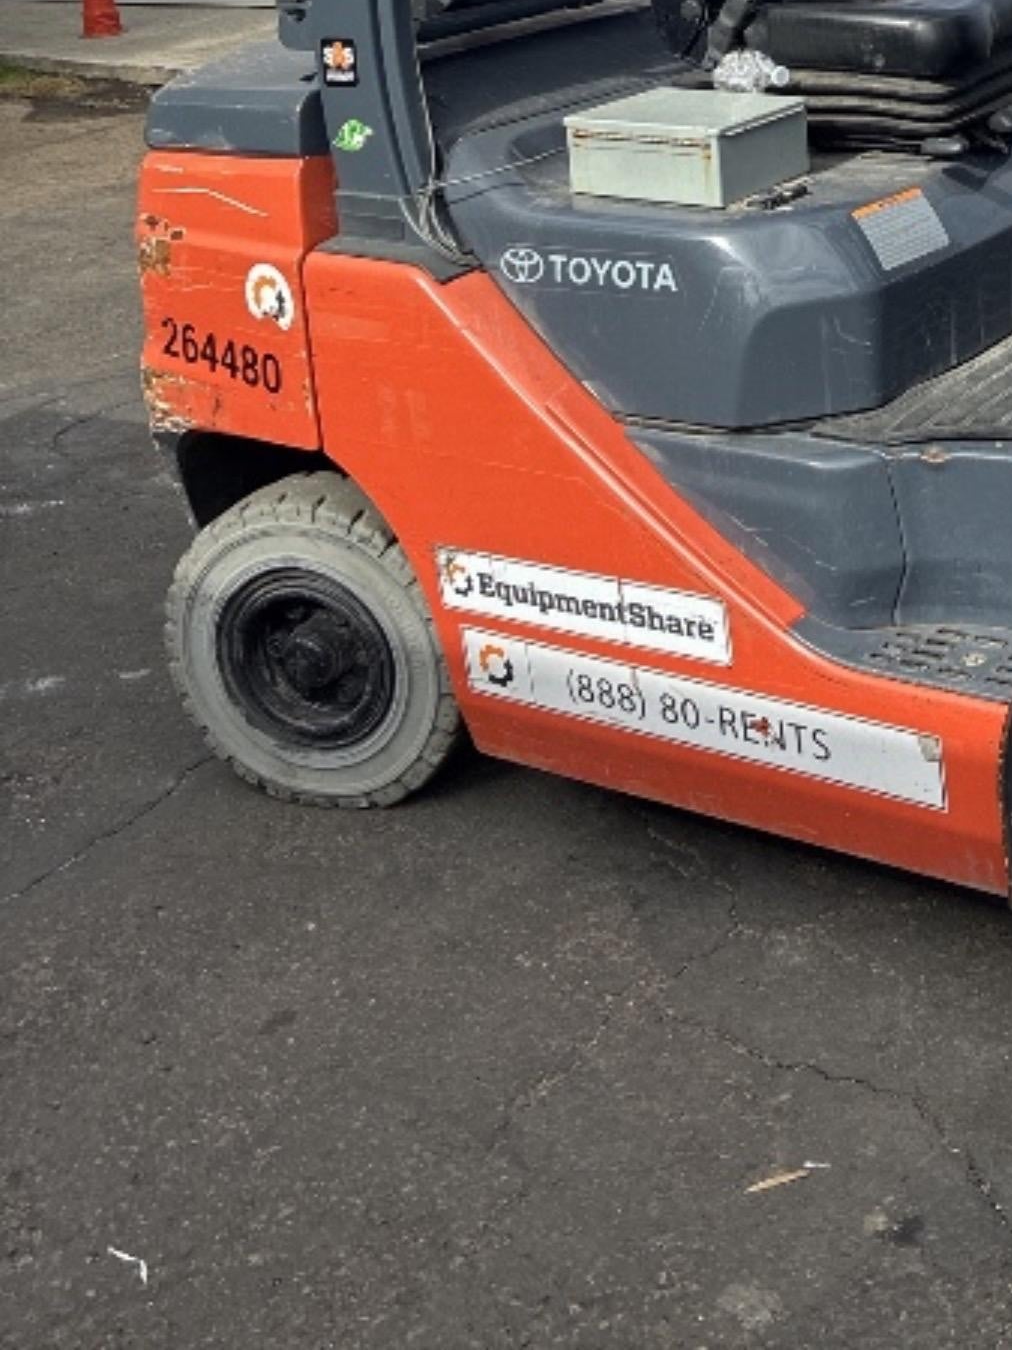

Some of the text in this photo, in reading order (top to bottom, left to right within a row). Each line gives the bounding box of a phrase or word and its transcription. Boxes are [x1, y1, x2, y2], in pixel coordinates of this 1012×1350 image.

[547, 253, 679, 292] TOYOTA
[161, 317, 283, 394] 264480
[476, 572, 715, 642] EquipmentShare
[566, 668, 832, 762] (888) 80-RENTS
